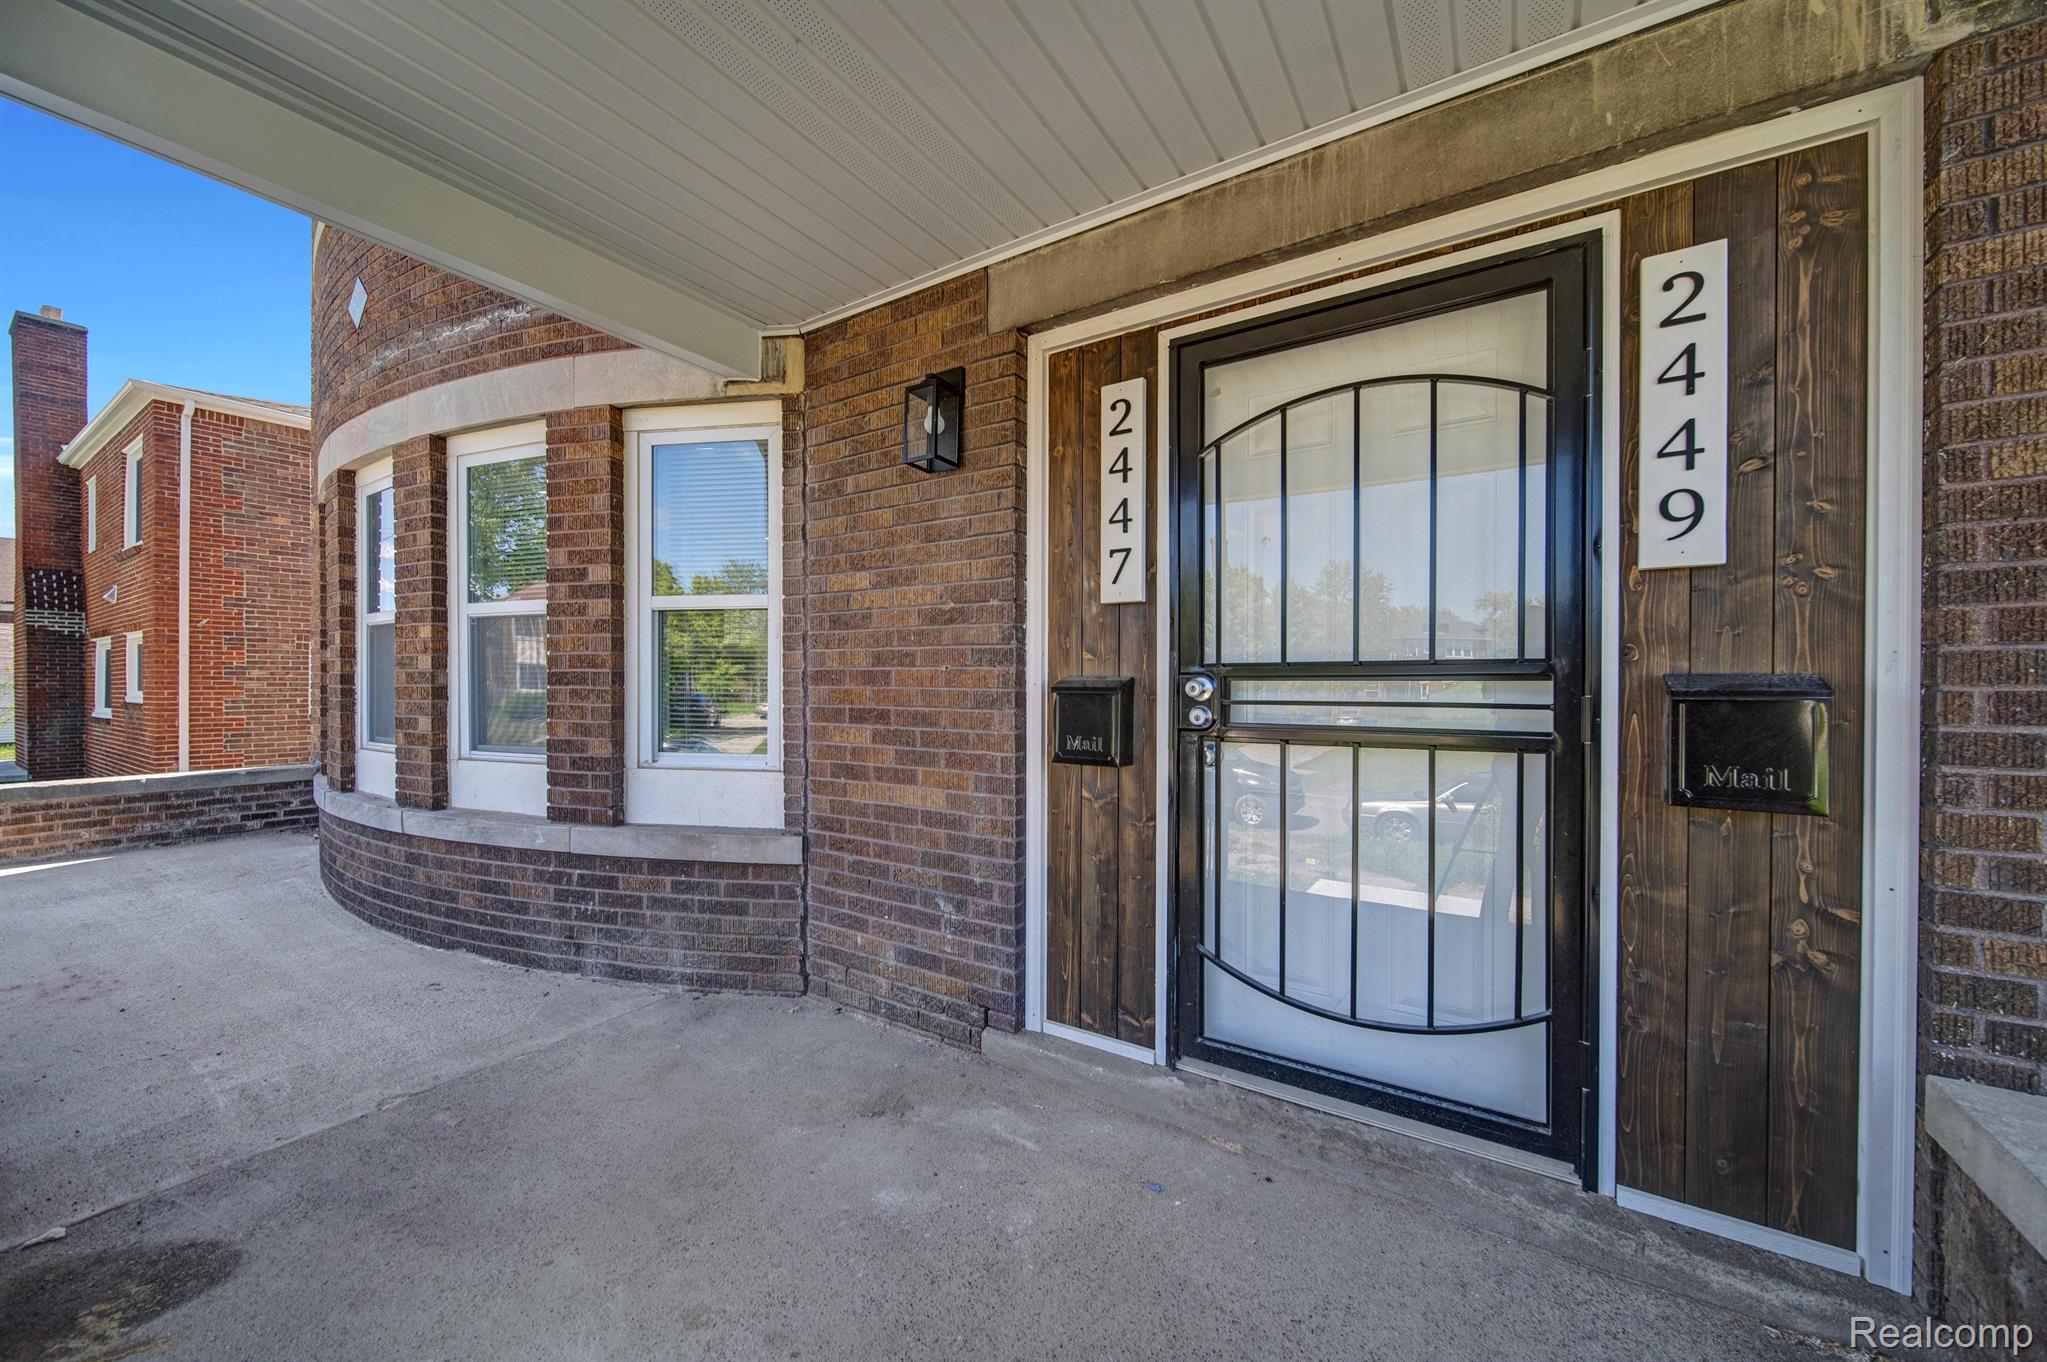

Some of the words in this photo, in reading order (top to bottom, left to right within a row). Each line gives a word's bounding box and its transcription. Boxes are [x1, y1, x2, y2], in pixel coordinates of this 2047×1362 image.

[1657, 270, 1707, 542] 2449
[1108, 398, 1133, 585] 2447
[1065, 734, 1103, 752] Mail
[1703, 764, 1792, 792] Mail
